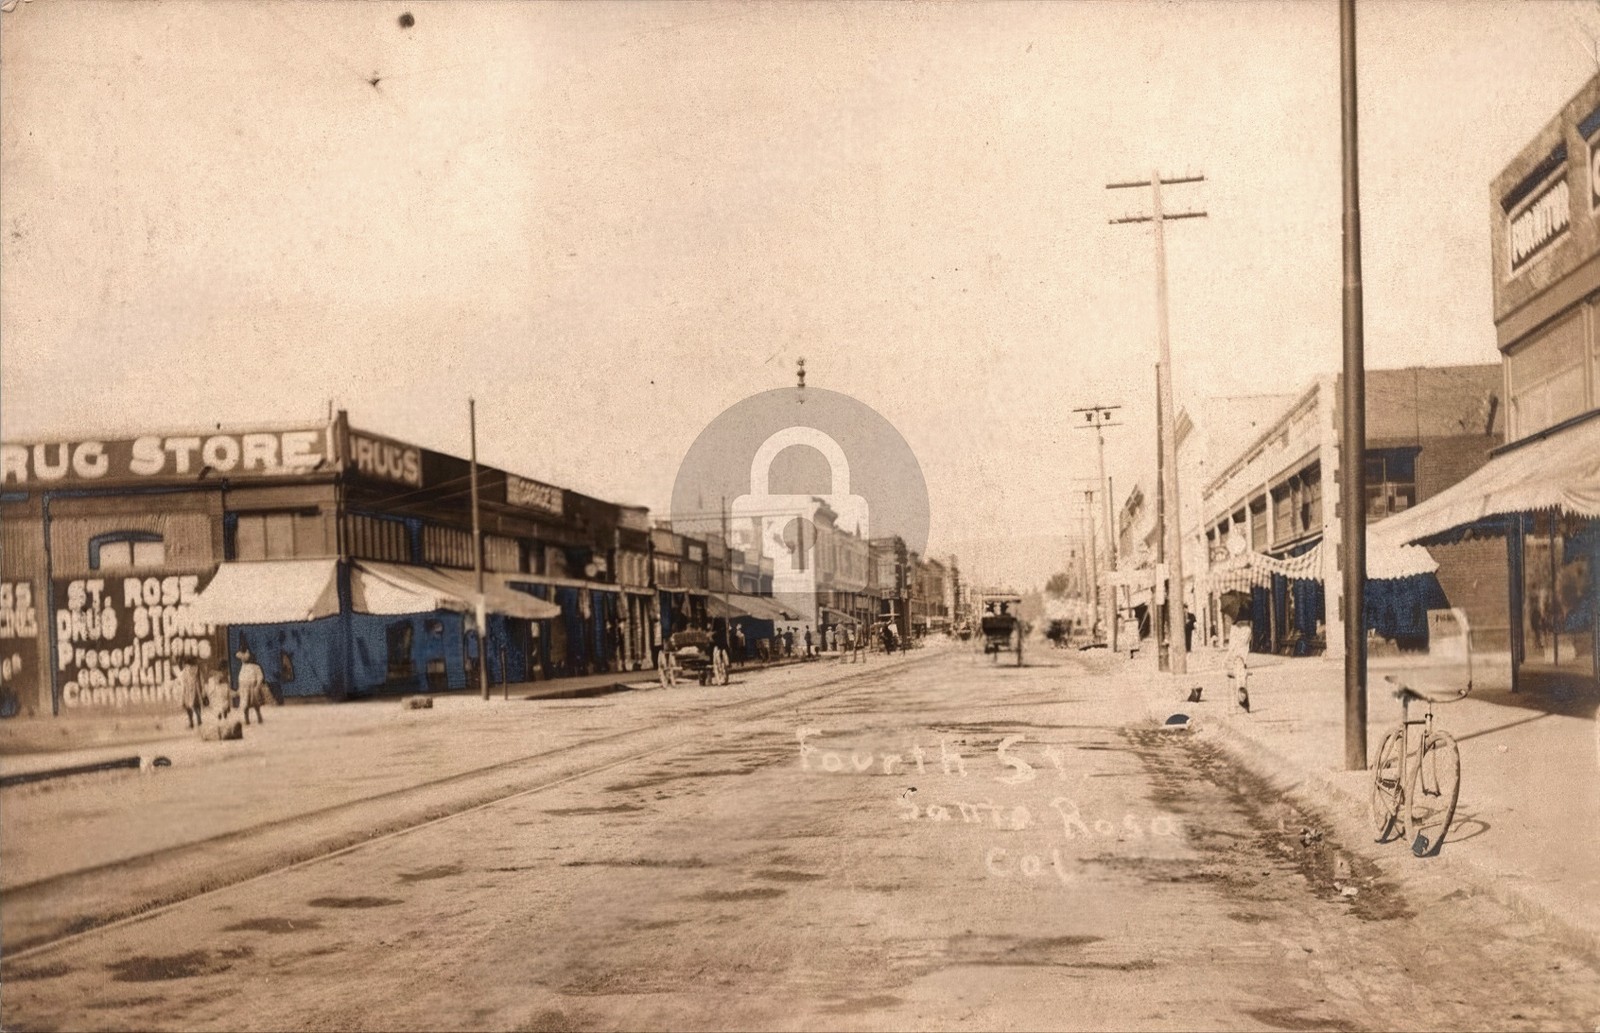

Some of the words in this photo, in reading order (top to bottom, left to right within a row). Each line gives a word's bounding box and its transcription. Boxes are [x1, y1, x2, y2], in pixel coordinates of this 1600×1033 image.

[129, 430, 324, 475] STORE
[123, 575, 199, 607] ROSE
[56, 606, 117, 641] DRUG
